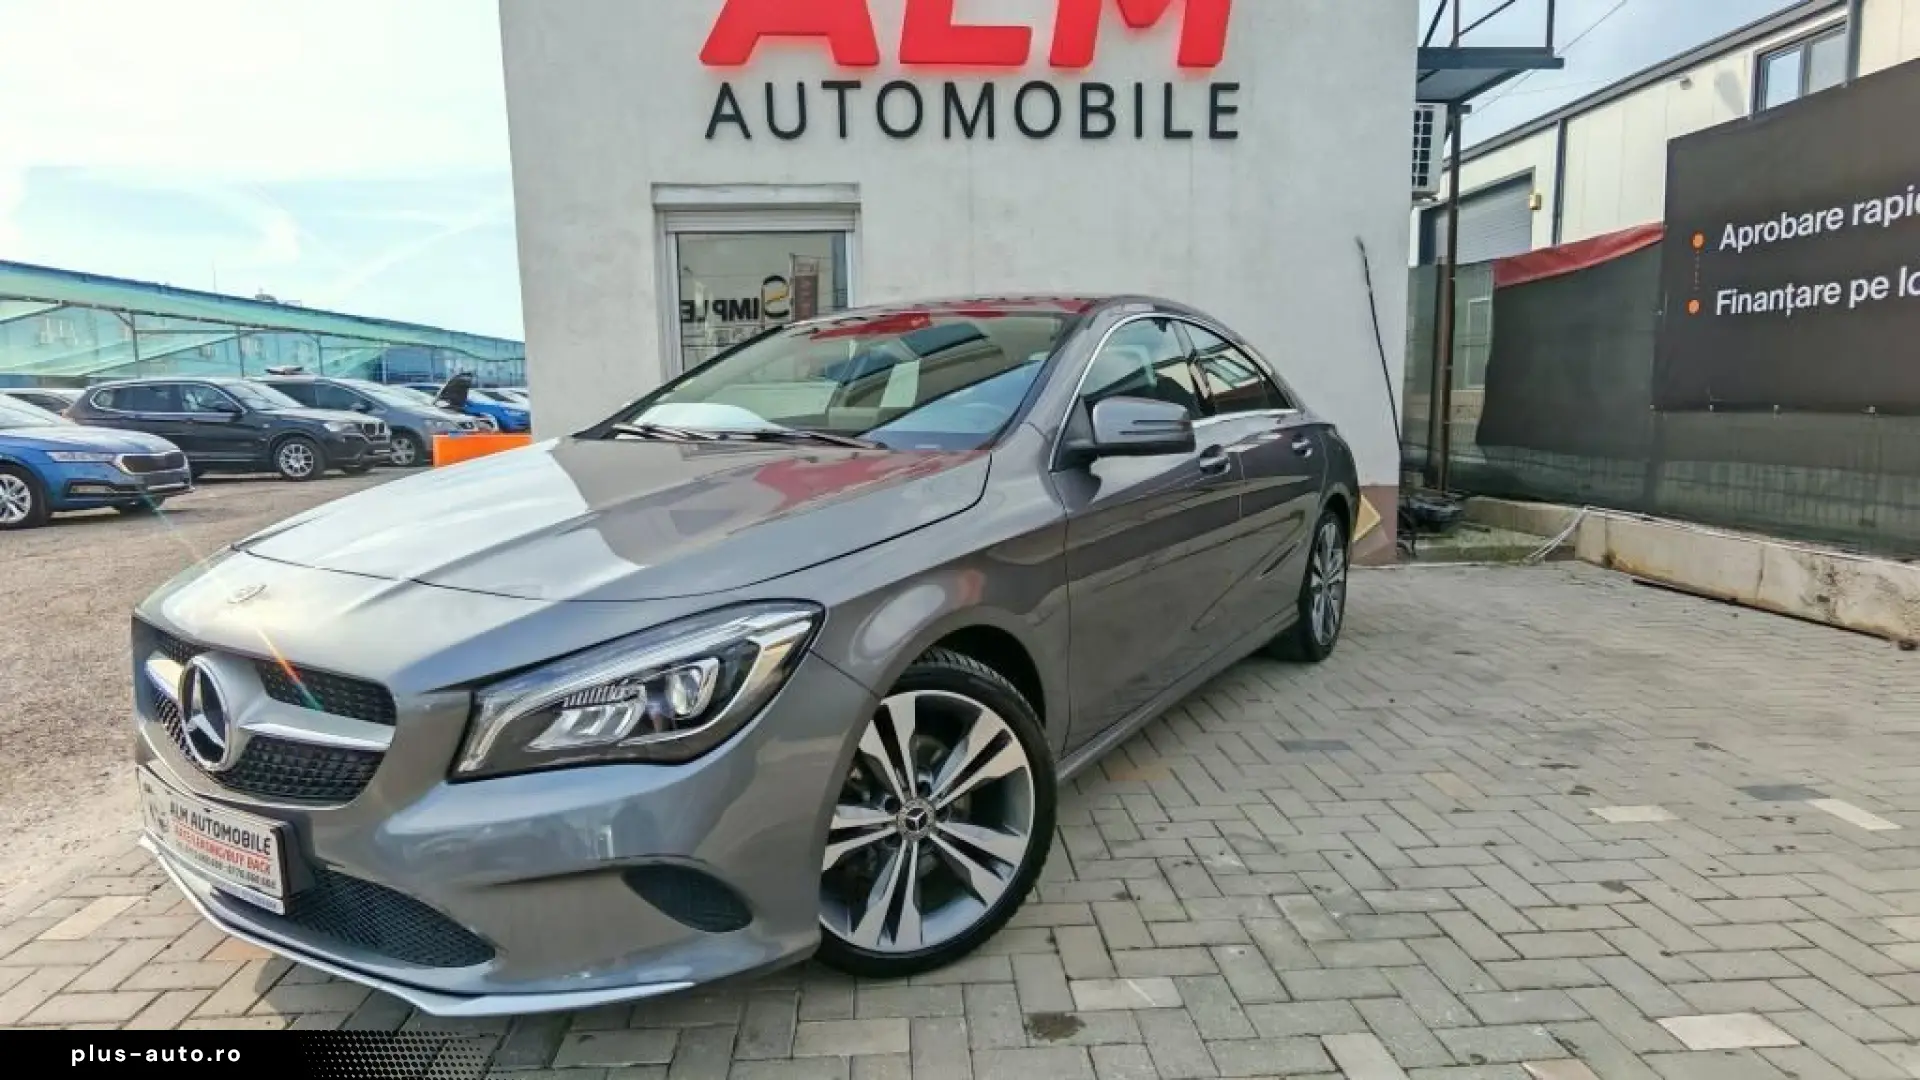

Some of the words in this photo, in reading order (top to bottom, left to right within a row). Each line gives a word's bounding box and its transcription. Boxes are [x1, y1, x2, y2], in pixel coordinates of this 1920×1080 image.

[704, 81, 1240, 140] AUTOMOBILE
[1718, 207, 1844, 254] Aprobare
[1852, 185, 1920, 227] rapi
[1715, 281, 1841, 317] Finanțare
[1848, 274, 1890, 309] pe
[190, 811, 271, 856] AUTOMOBILE
